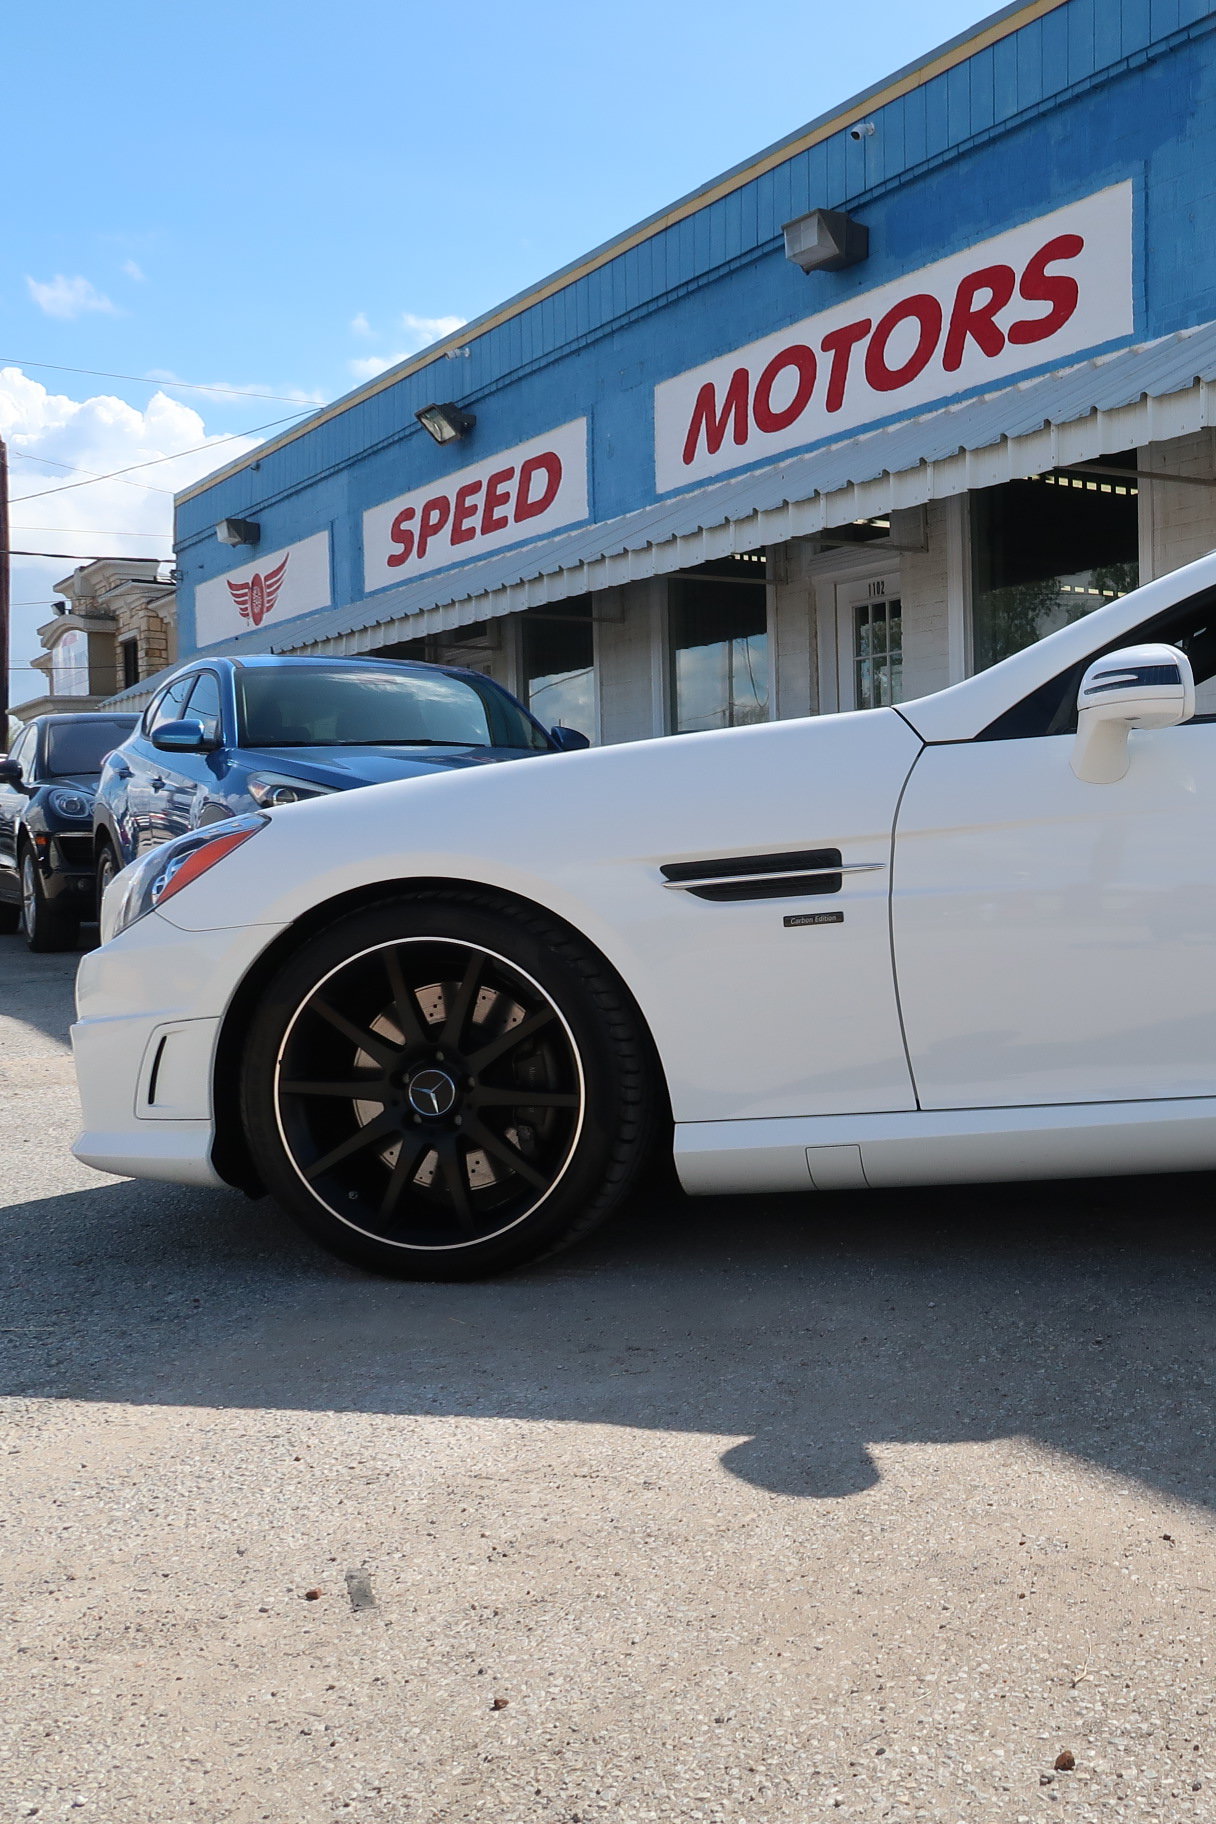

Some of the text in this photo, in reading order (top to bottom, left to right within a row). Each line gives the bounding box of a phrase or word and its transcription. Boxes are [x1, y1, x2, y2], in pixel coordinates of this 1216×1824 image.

[682, 234, 1084, 465] MOTORS
[387, 451, 562, 568] SPEED
[868, 581, 885, 597] 1102
[790, 914, 837, 925] Carbon Edition
